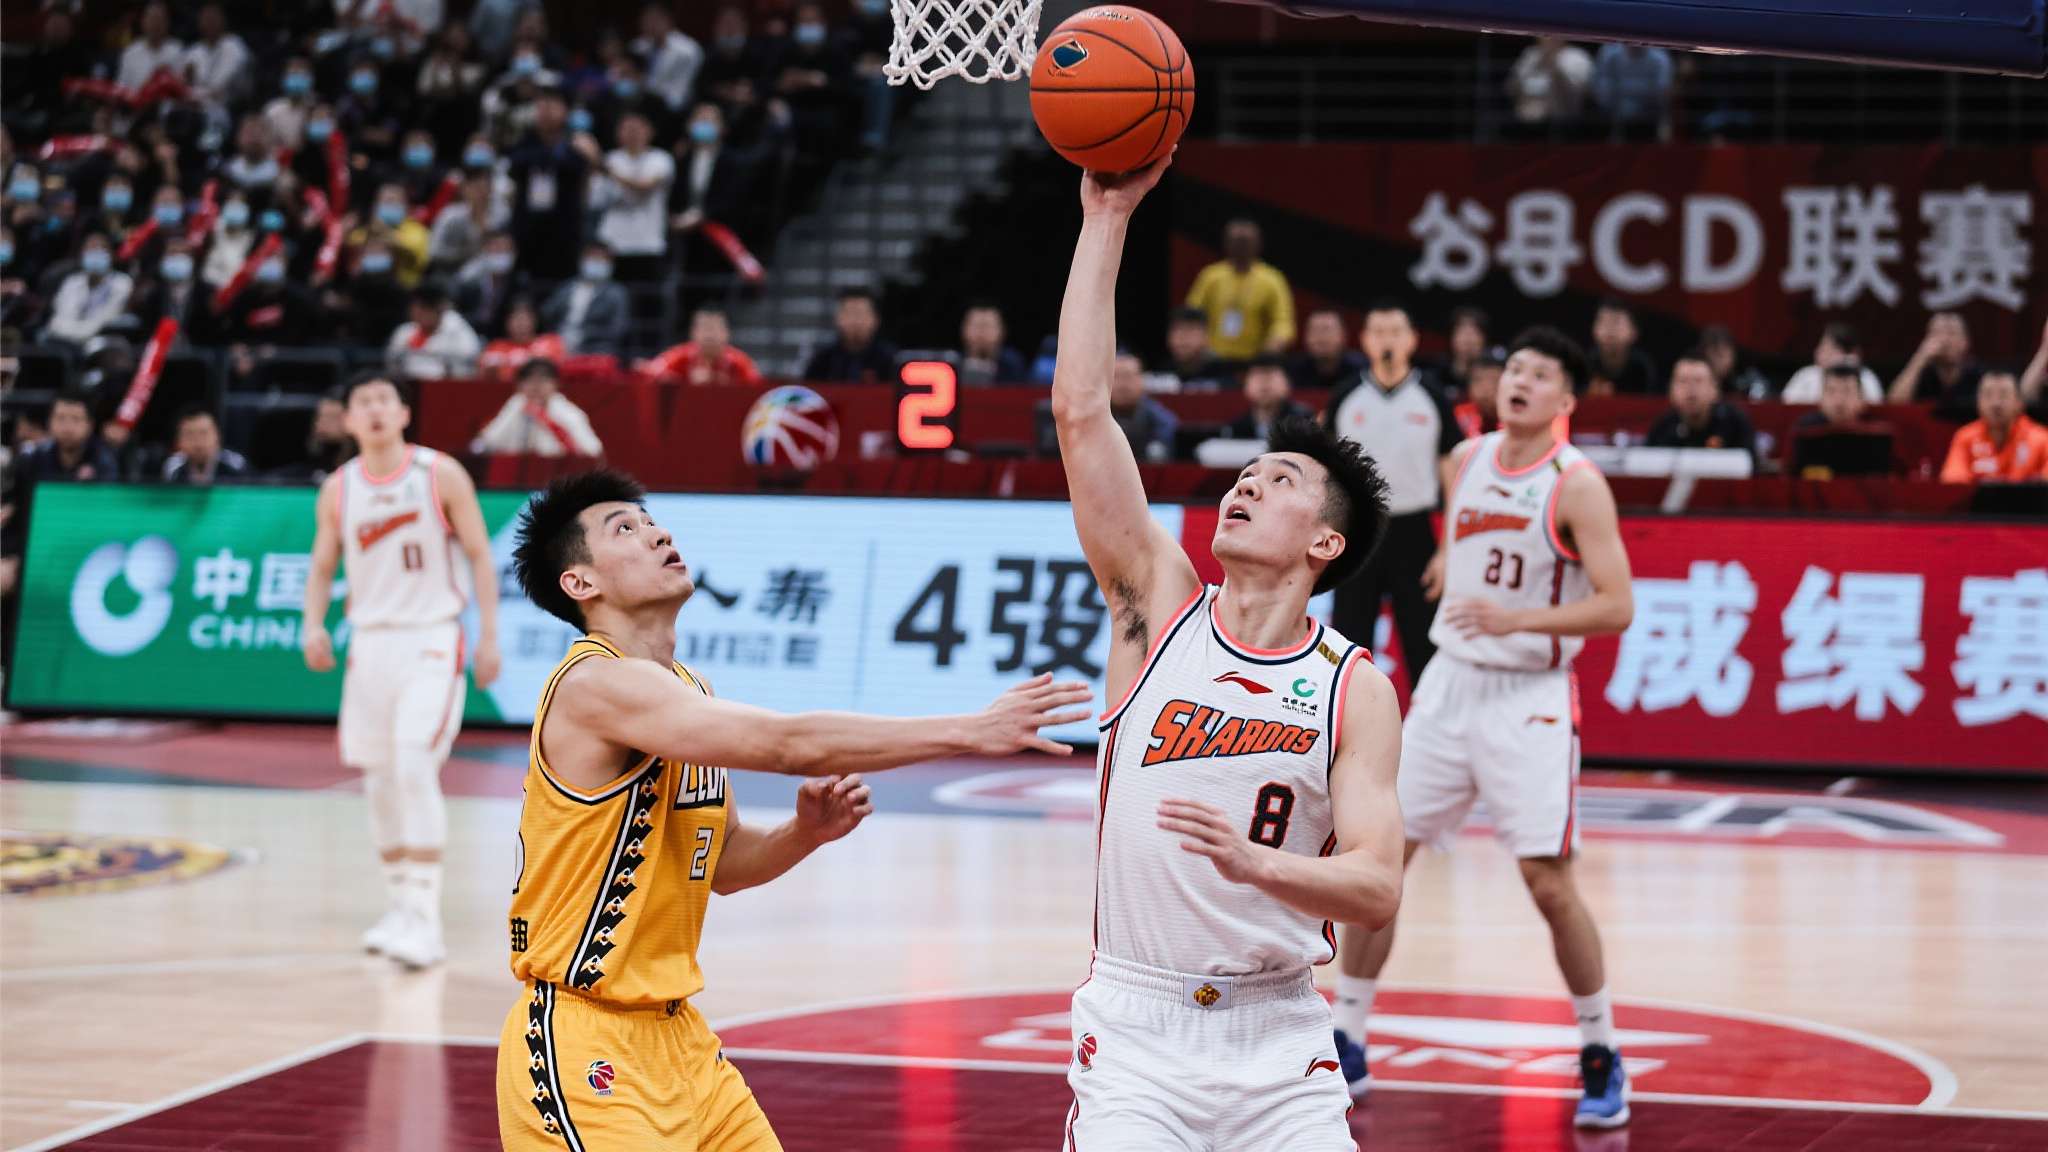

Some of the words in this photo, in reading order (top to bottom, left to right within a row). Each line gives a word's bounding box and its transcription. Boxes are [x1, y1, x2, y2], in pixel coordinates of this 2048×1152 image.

[898, 361, 957, 449] 2
[1248, 781, 1295, 849] 8
[689, 827, 715, 881] 2
